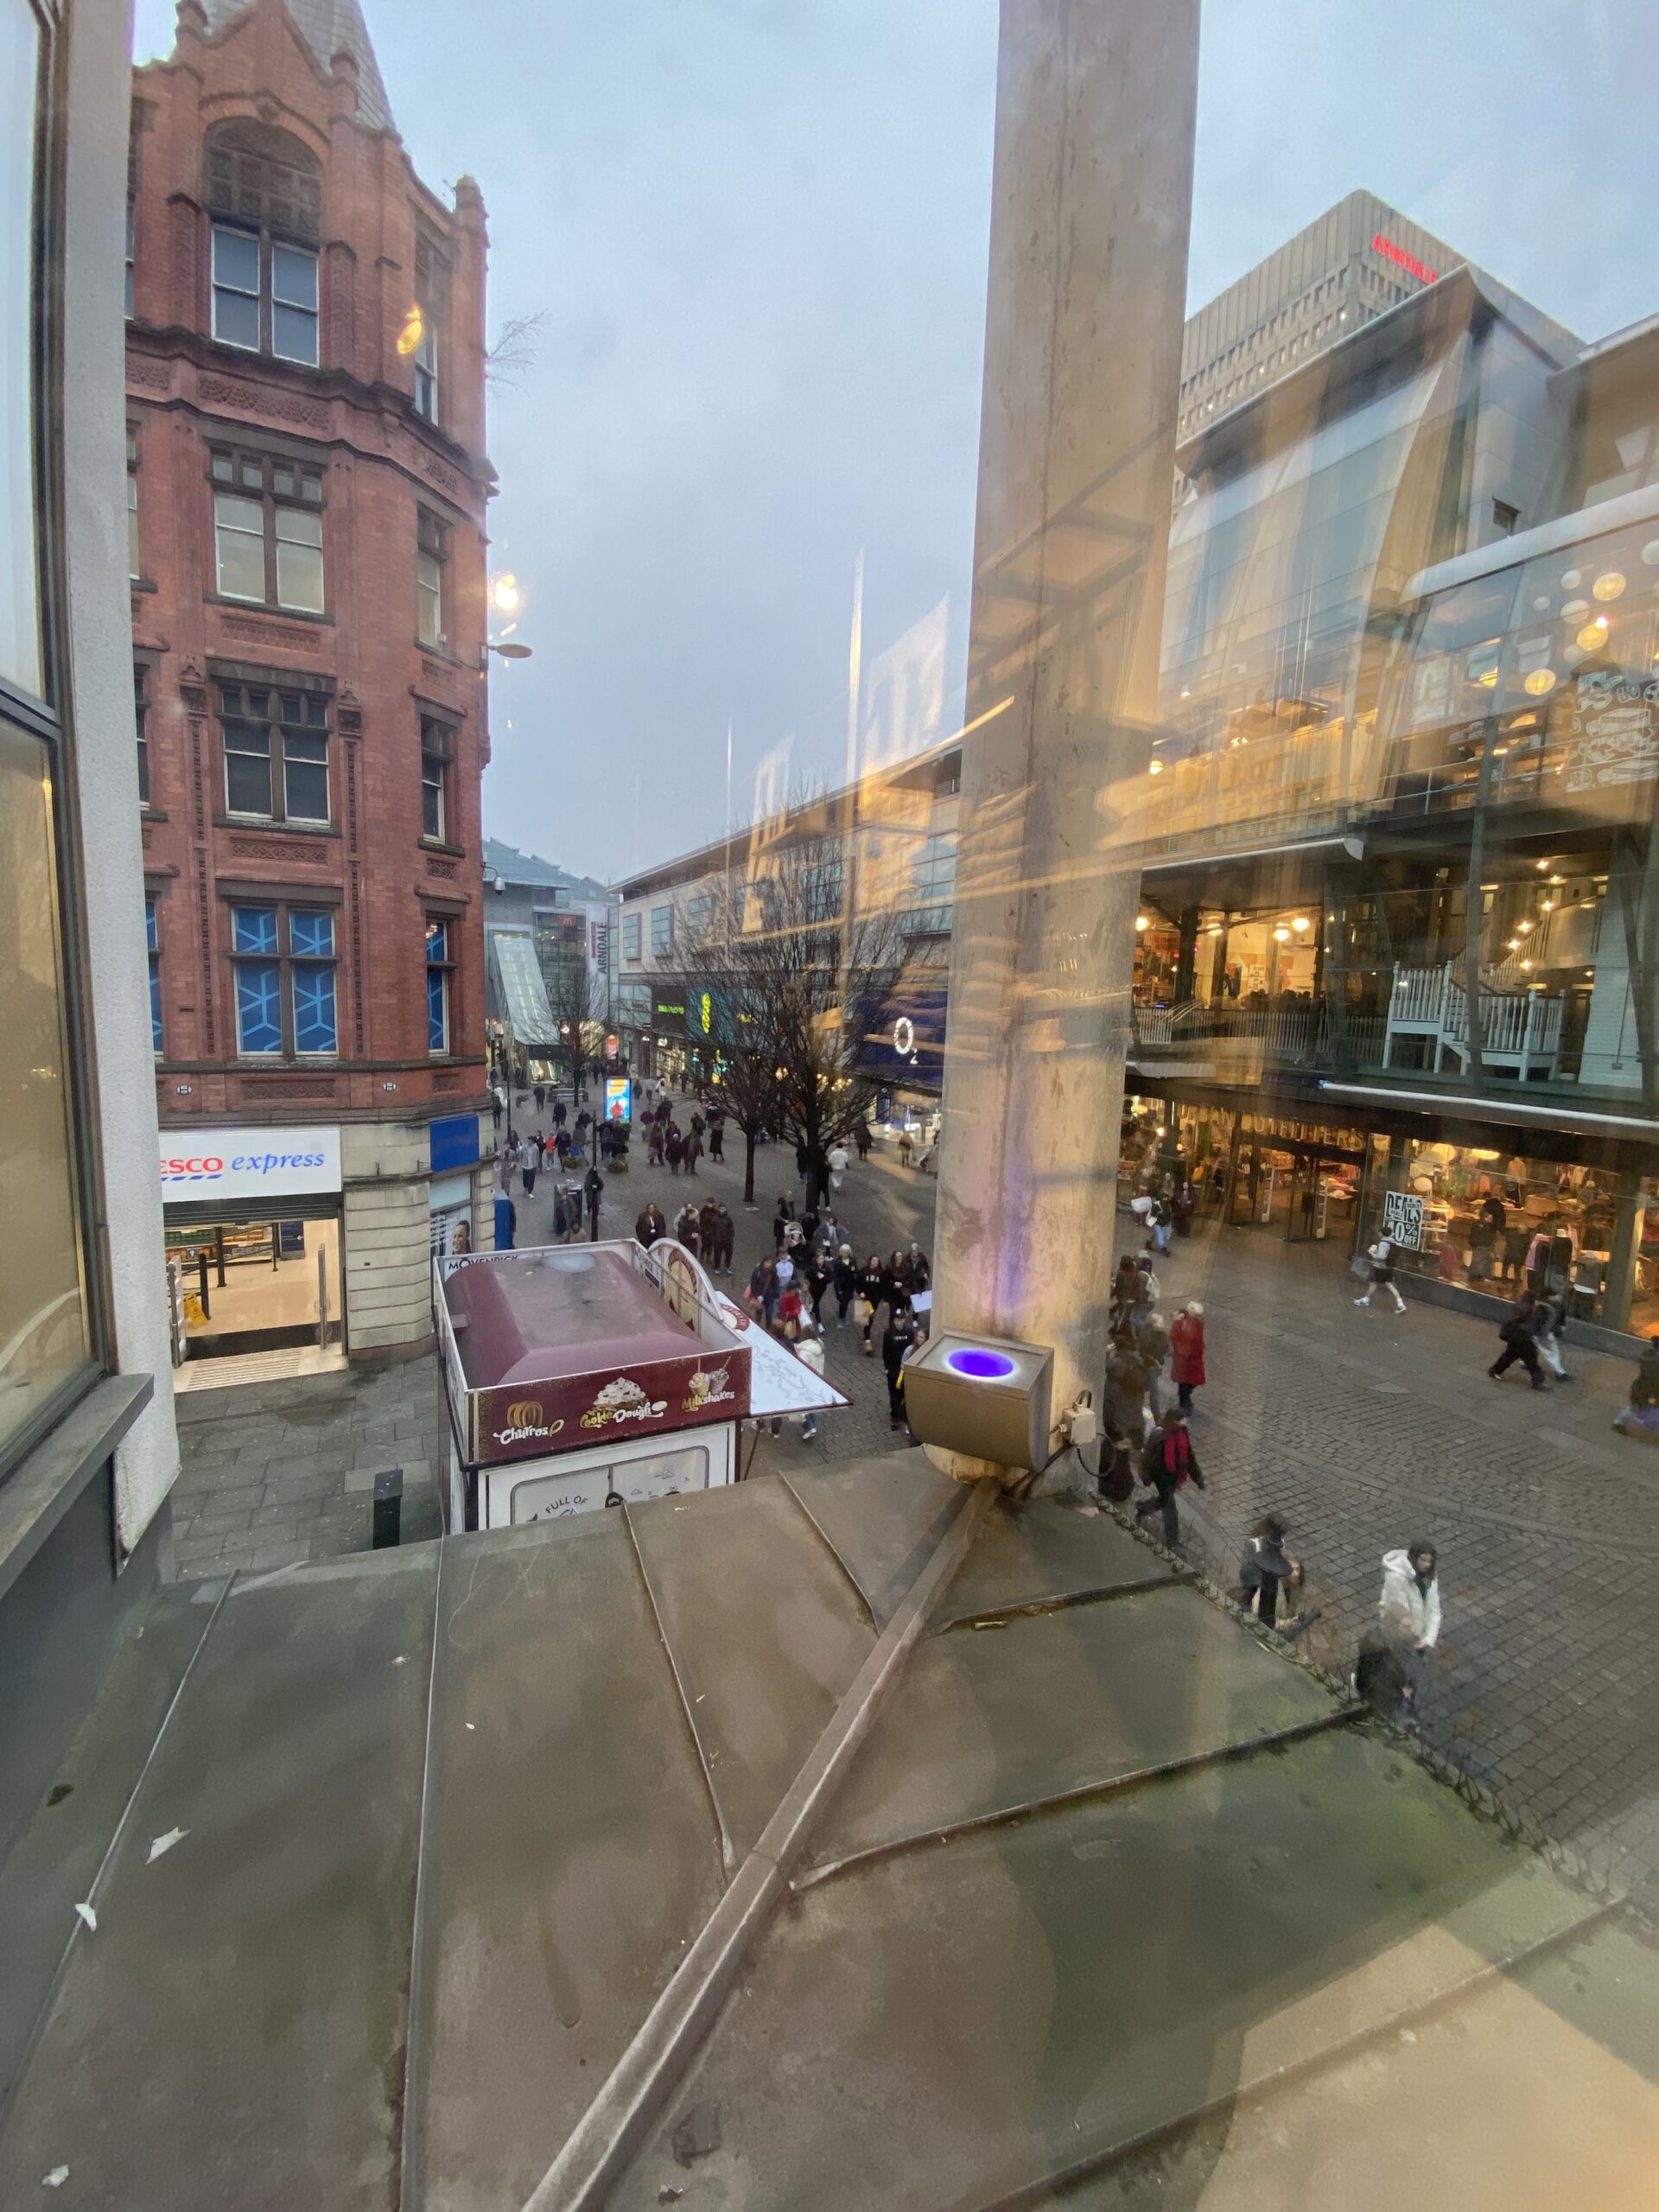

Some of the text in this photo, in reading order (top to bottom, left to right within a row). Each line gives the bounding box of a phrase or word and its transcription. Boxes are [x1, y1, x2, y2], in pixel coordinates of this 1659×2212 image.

[1372, 233, 1437, 285] ARNDALE
[597, 921, 607, 975] ARNDALE
[232, 1154, 325, 1175] express
[1386, 1193, 1421, 1224] DEALS
[1403, 1235, 1416, 1245] OFF
[682, 1390, 735, 1413] Milkshakes
[580, 1401, 652, 1429] Cookie Dough
[493, 1426, 549, 1446] Churros
[545, 1495, 588, 1514] FULL OF
